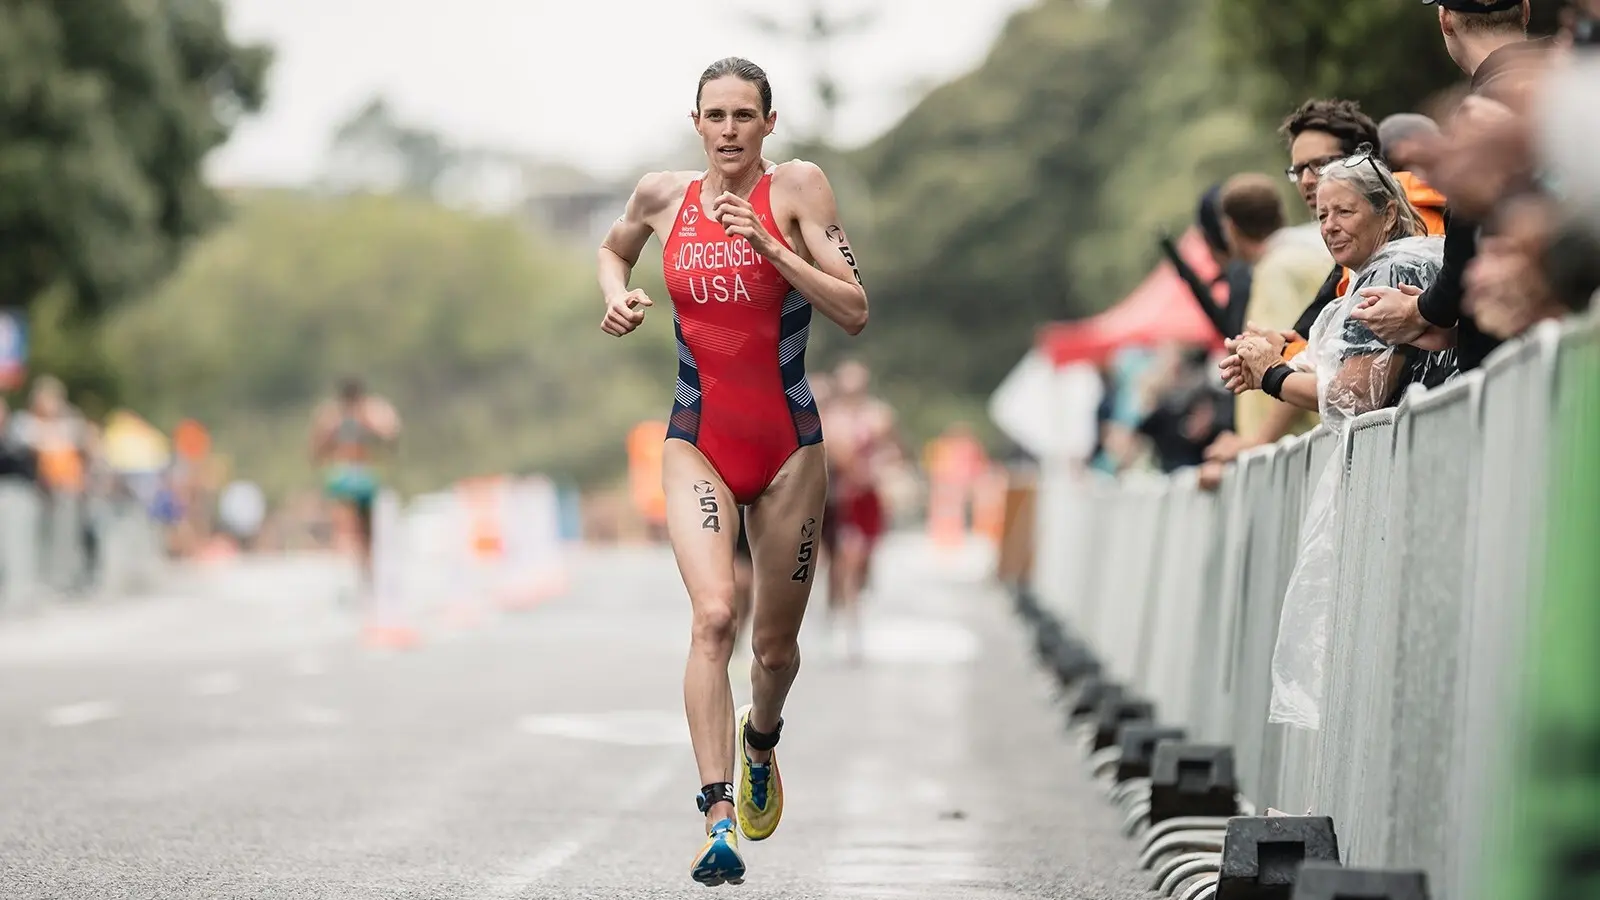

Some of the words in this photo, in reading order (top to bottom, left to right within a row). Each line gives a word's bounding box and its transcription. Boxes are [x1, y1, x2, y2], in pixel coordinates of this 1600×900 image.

[675, 237, 762, 270] JORGENSEN
[689, 274, 751, 304] USA
[699, 496, 721, 533] 54
[791, 541, 813, 583] 54
